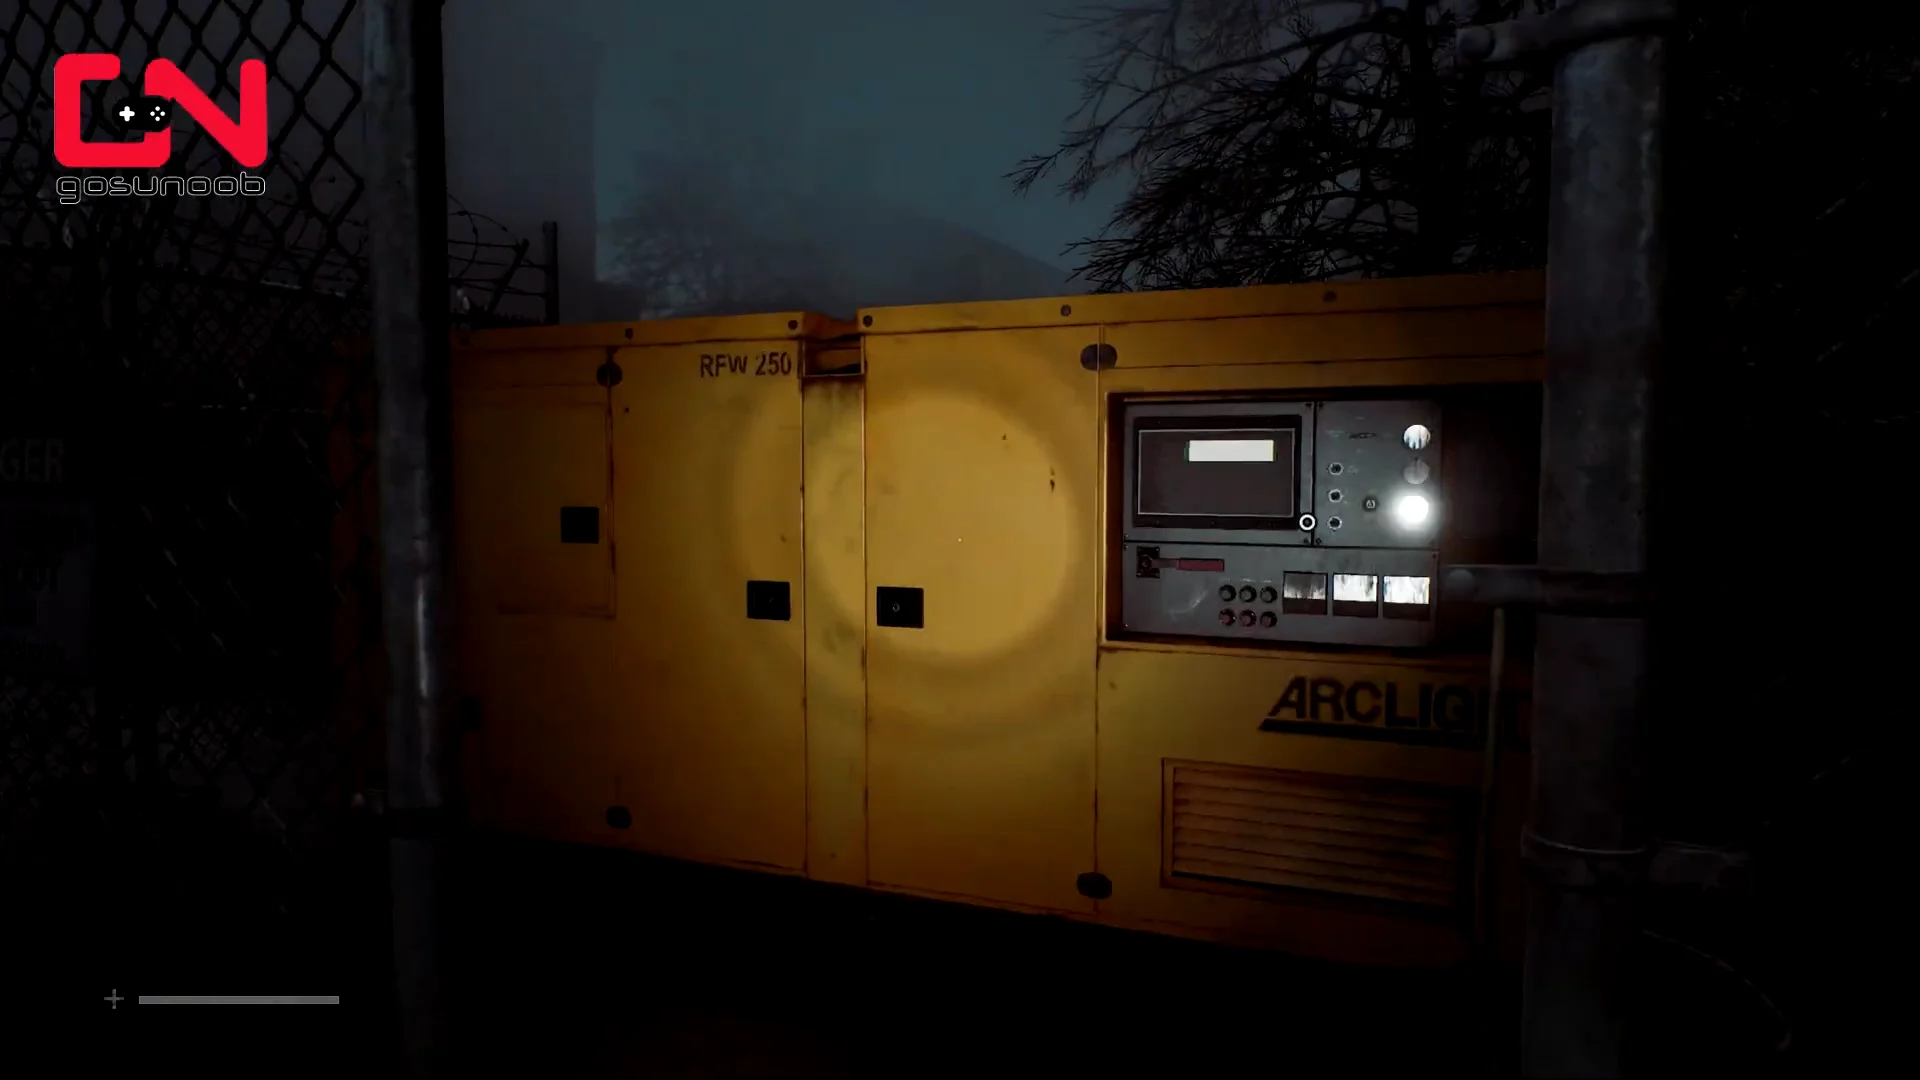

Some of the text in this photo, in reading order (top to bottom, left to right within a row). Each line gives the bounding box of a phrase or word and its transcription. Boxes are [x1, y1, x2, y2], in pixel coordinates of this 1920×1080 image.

[700, 351, 791, 378] RFW 250
[1266, 675, 1531, 737] ARCLIG
